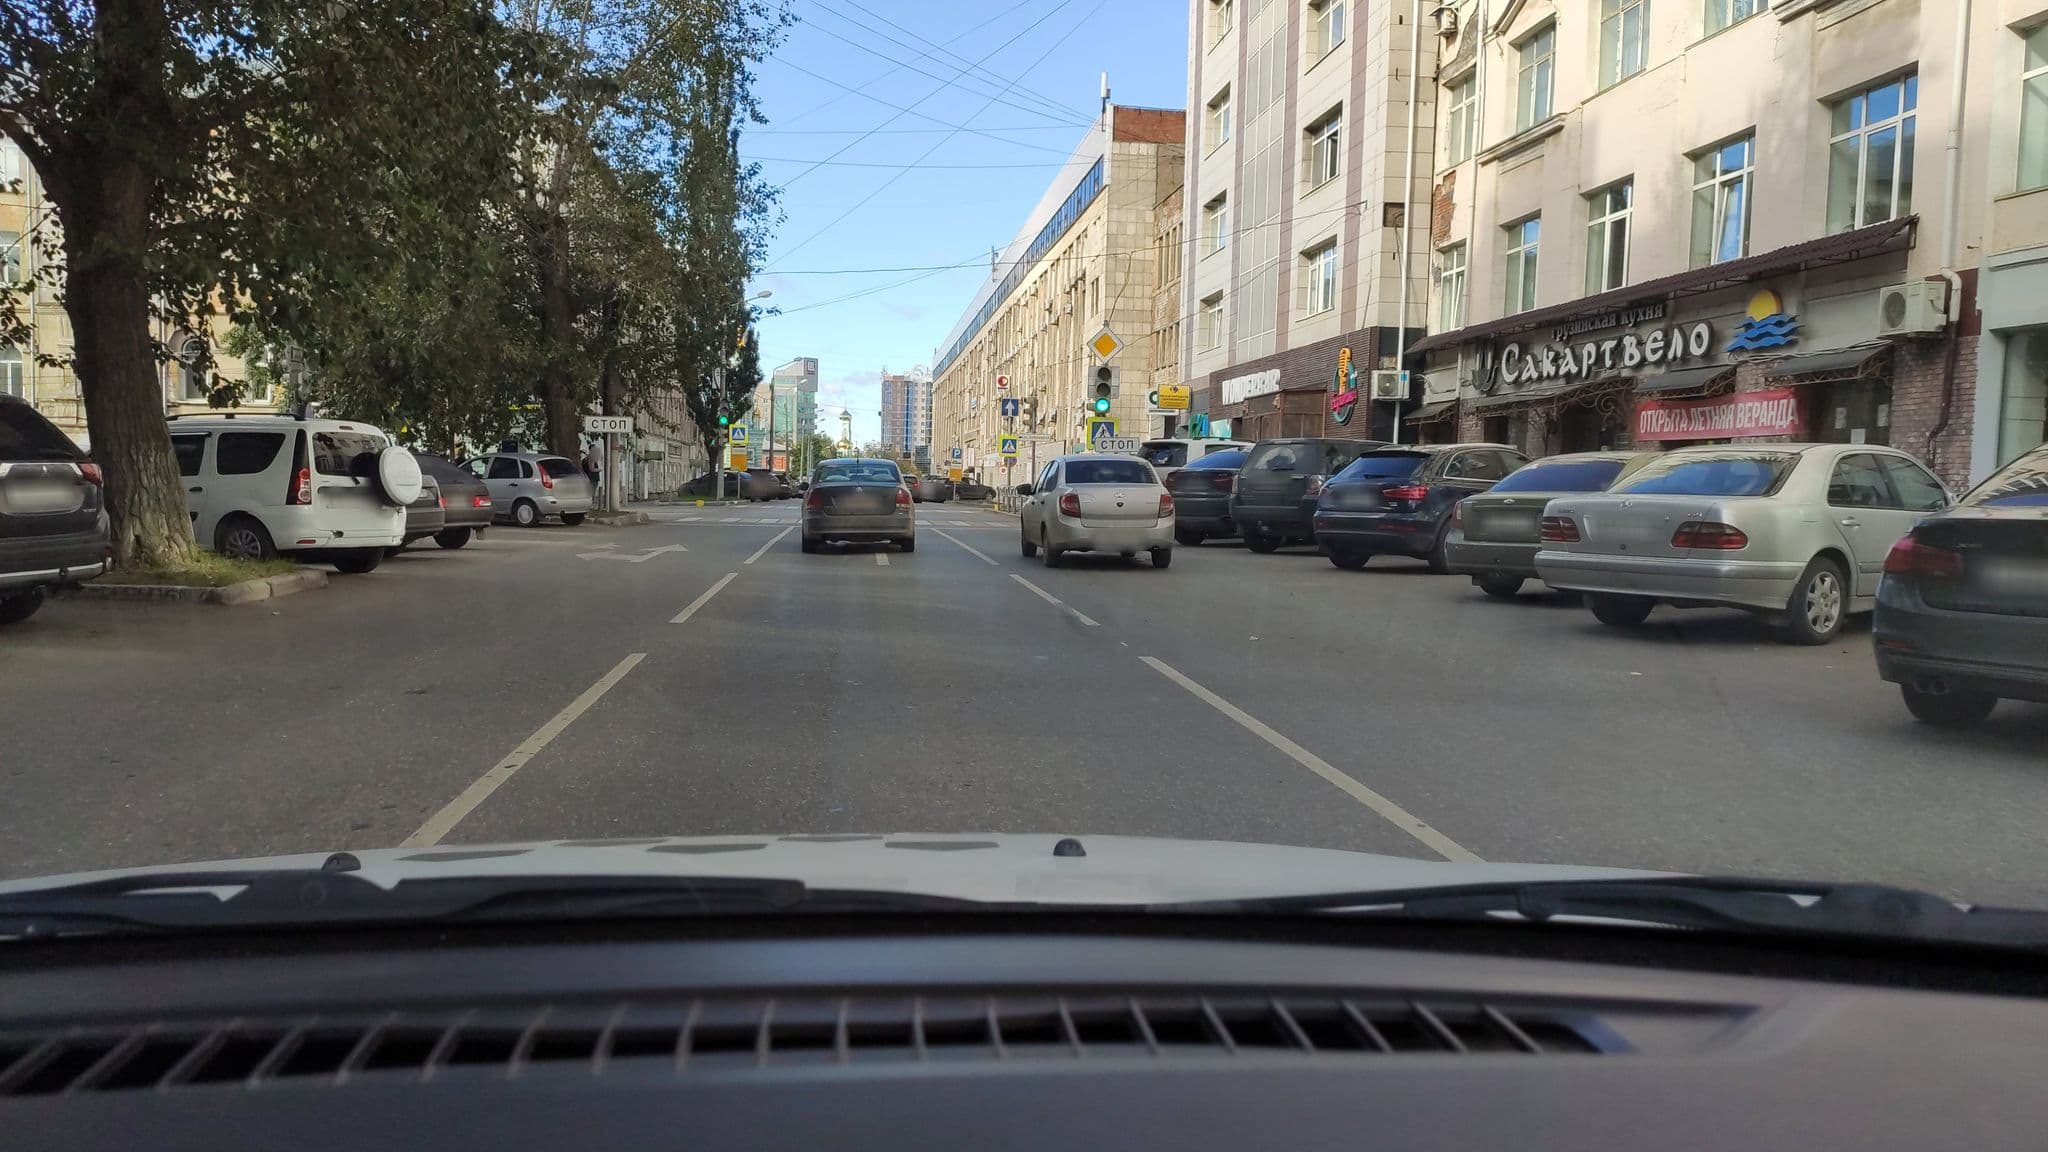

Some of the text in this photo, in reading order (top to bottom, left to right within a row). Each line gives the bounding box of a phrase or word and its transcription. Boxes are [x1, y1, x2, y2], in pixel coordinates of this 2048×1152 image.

[1640, 399, 1799, 433] ОТКРЫТА ЛЕТНЯЯ ВЕРАНДА
[591, 419, 626, 430] СТОП
[1100, 439, 1134, 450] СТОП
